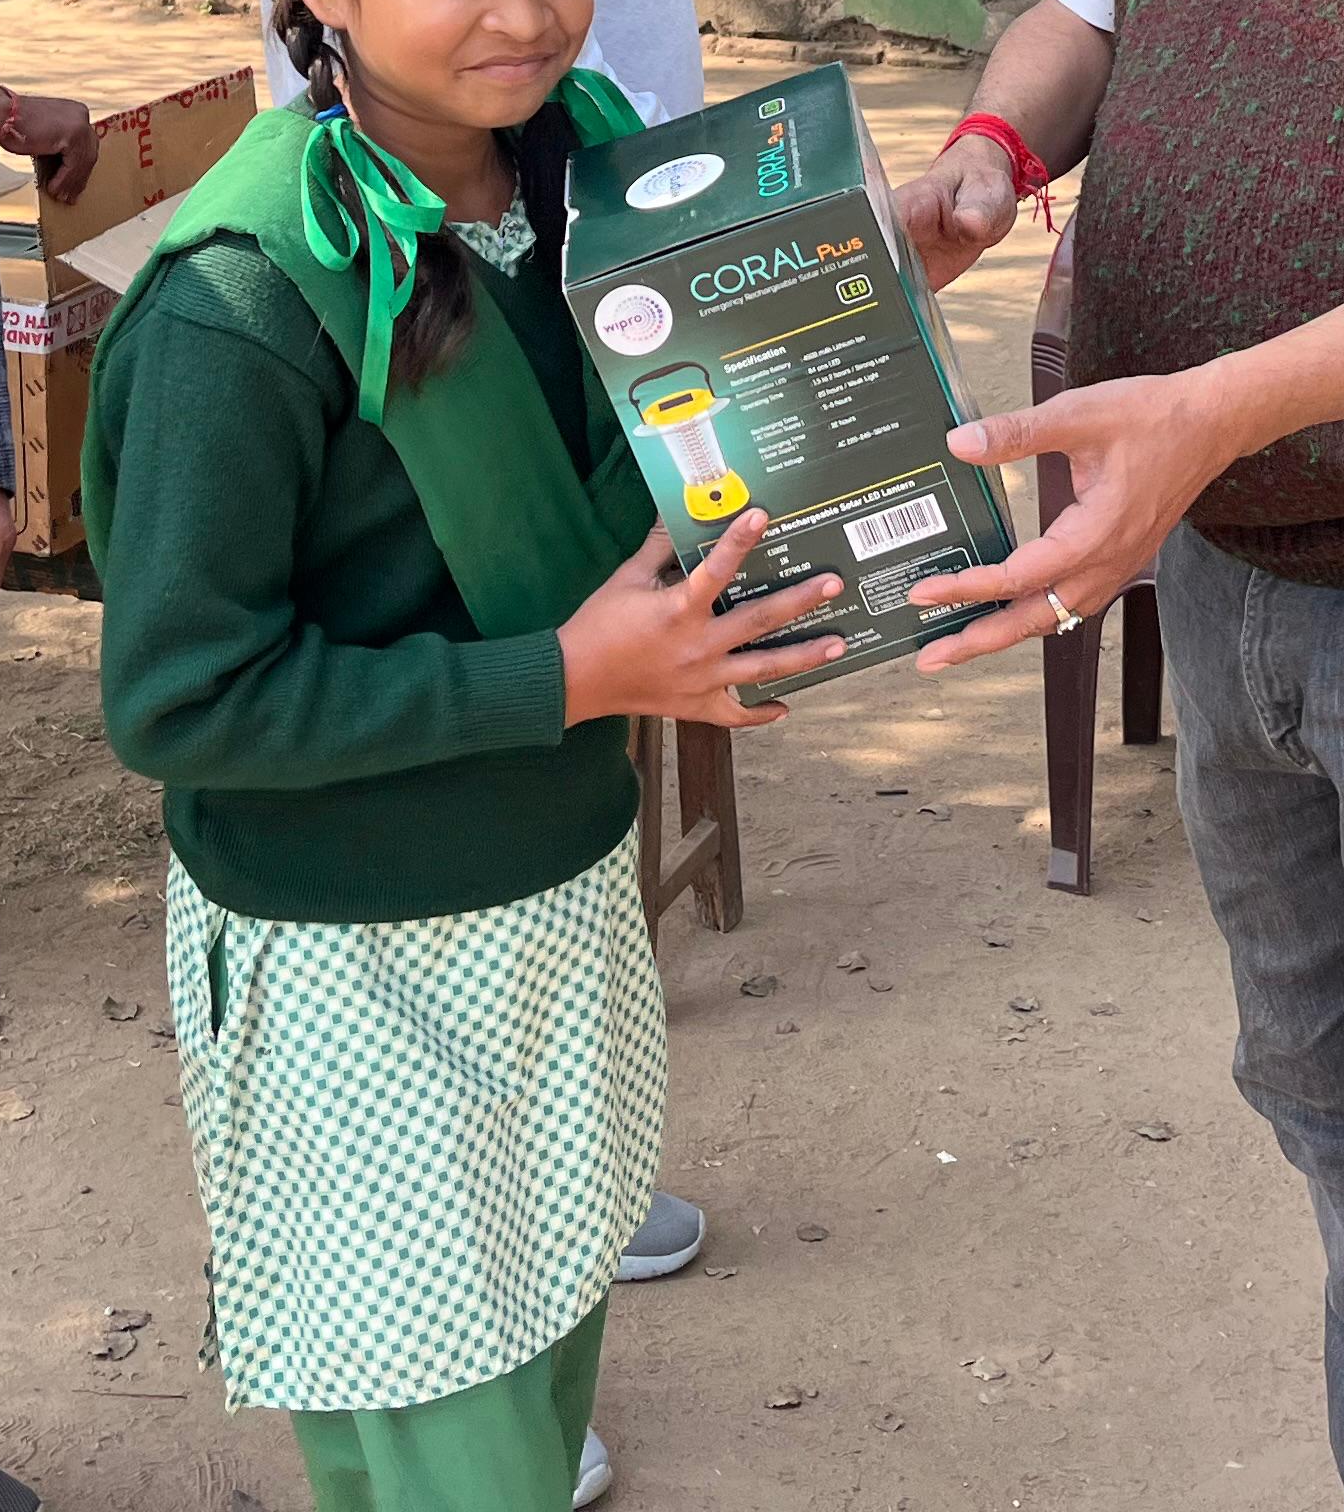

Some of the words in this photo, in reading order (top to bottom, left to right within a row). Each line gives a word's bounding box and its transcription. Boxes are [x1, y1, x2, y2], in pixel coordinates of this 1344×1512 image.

[756, 138, 790, 197] CORAL
[690, 241, 819, 303] CORAL
[836, 252, 868, 269] Lantern
[840, 279, 868, 300] LED
[603, 314, 642, 334] wipro
[724, 346, 787, 374] Specification
[782, 506, 840, 532] Rechargeable
[839, 498, 864, 512] Solar
[862, 491, 881, 504] LED
[880, 480, 915, 497] Lantern
